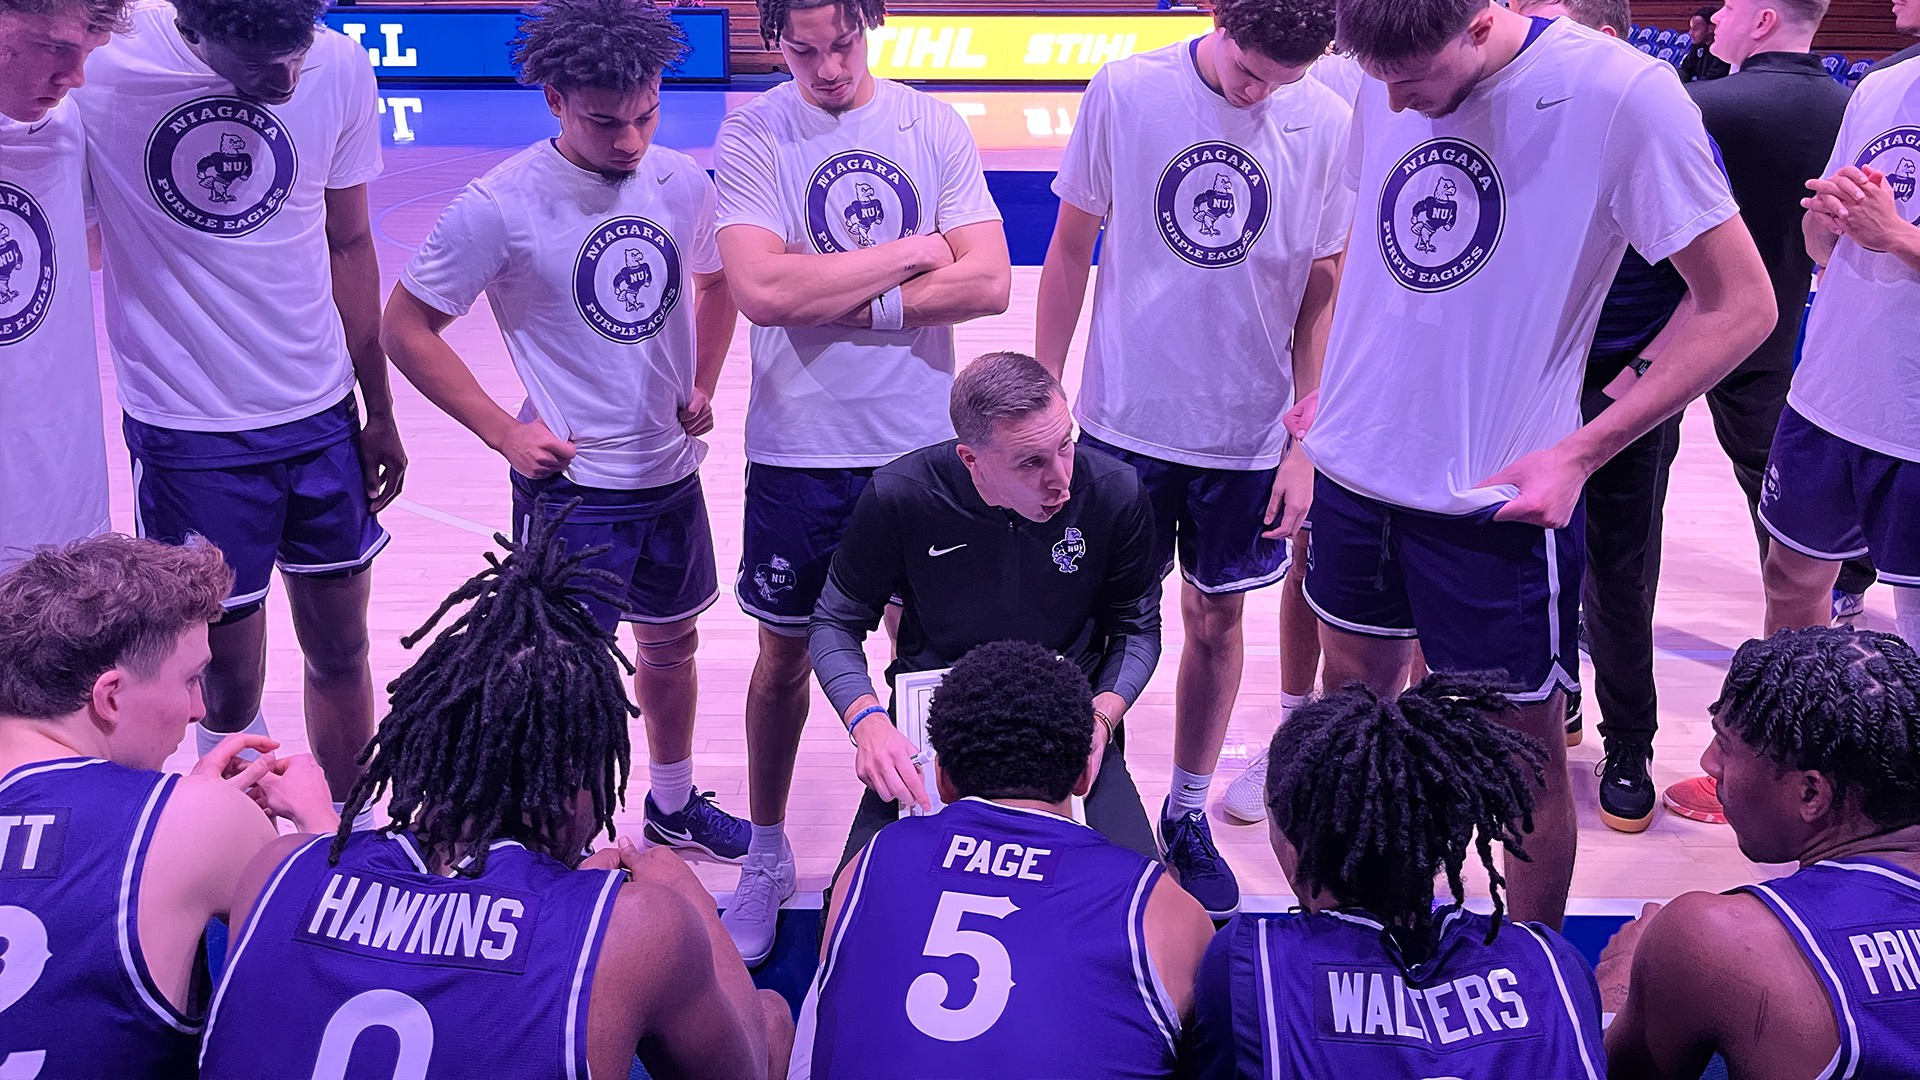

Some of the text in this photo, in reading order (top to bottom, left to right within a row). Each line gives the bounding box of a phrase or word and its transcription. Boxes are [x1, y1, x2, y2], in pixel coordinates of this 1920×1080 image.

[866, 27, 987, 68] TIHL
[169, 106, 279, 141] NIAGARA
[1869, 134, 1920, 156] NIAG
[222, 162, 242, 172] NU
[817, 159, 900, 188] NIAGARA
[1177, 150, 1260, 187] NIAGARA
[1402, 148, 1492, 191] NIAGARA
[157, 178, 284, 229] PURPLE EAGLES
[861, 207, 875, 218] NU
[1212, 198, 1229, 209] NU
[1432, 207, 1448, 220] NU
[586, 224, 665, 261] NIAGARA
[1162, 211, 1204, 259] PURPLE
[1383, 220, 1484, 283] PURPLE EAGLES
[629, 271, 645, 283] NU
[15, 266, 51, 331] EAGLES
[585, 302, 636, 336] PURPLE
[1067, 544, 1079, 553] NU
[771, 573, 786, 584] NU
[942, 834, 1051, 881] PAGE
[308, 873, 524, 961] HAWKINS
[906, 891, 1021, 1041] 5
[1849, 929, 1920, 995] PRU
